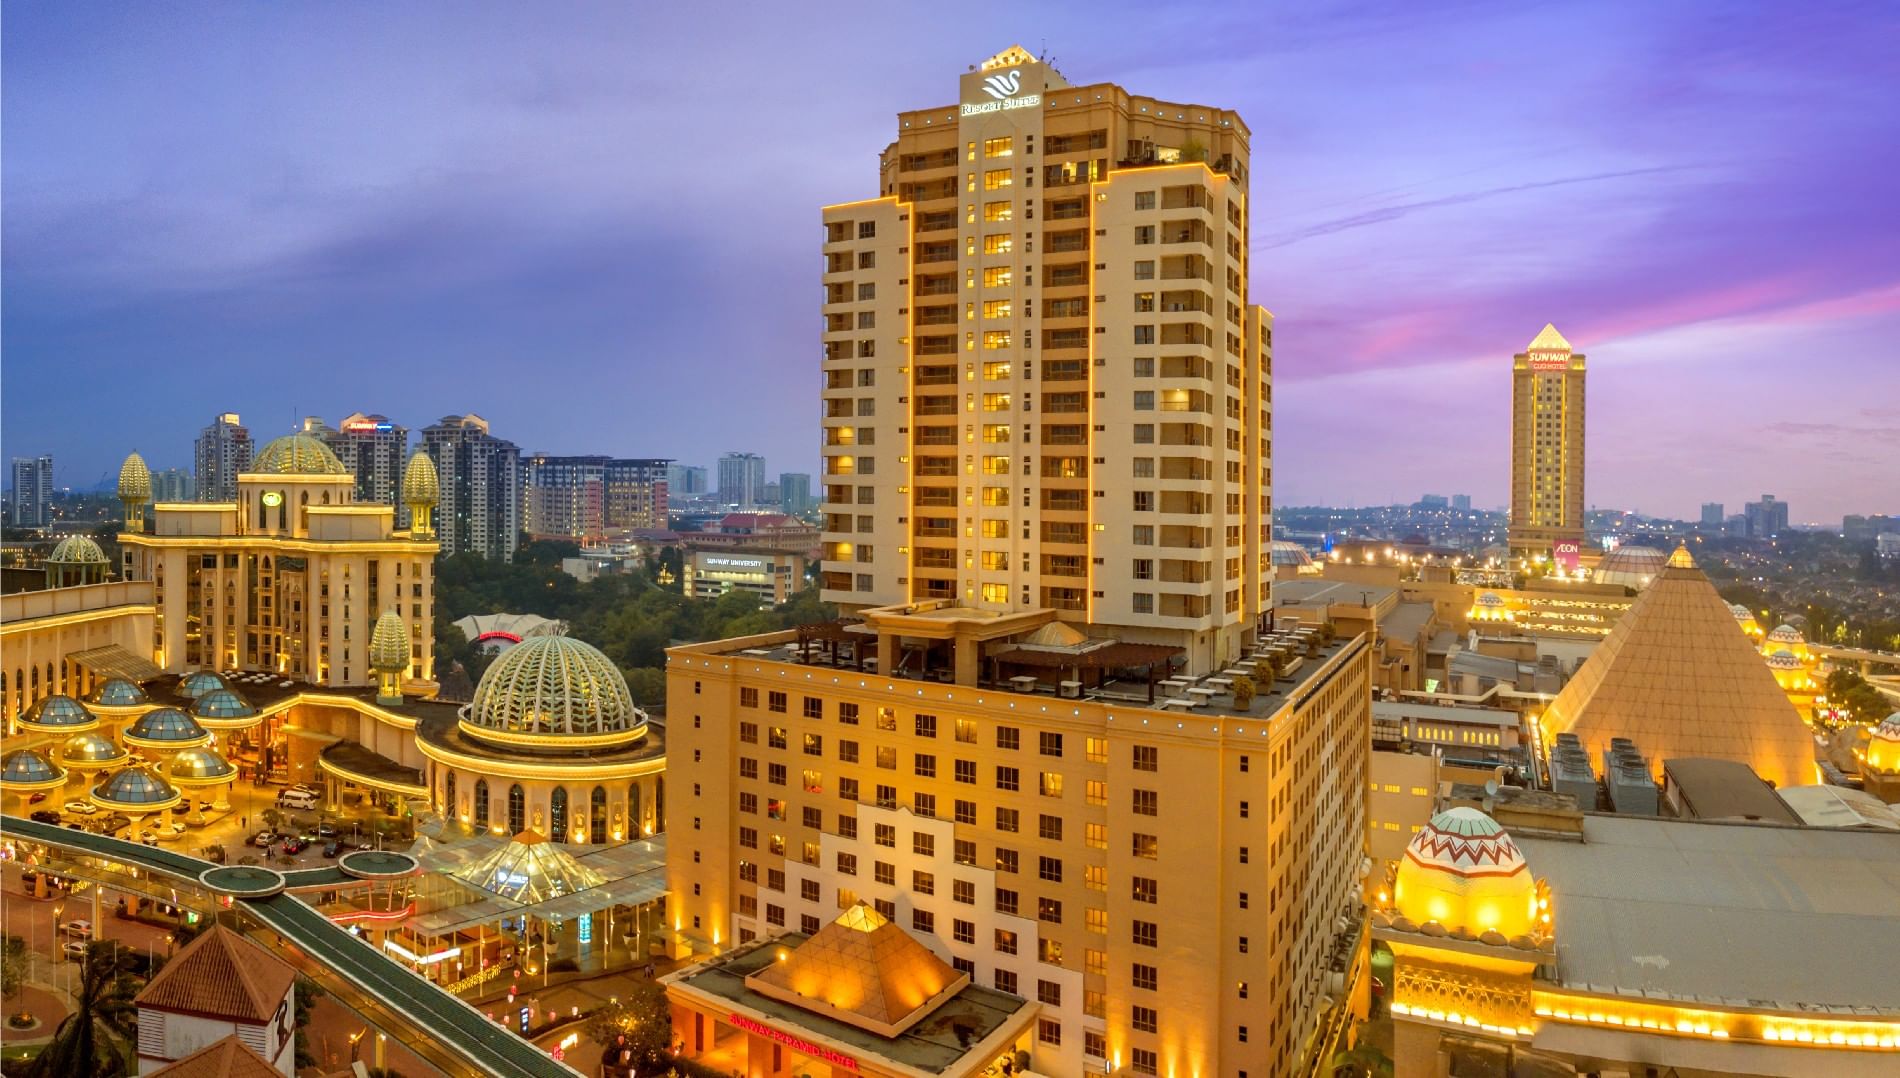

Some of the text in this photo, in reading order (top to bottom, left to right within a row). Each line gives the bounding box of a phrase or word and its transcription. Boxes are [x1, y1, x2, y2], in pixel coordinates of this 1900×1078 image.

[1528, 352, 1571, 362] SUNWAY
[730, 559, 762, 567] UNIVERSITY
[729, 1013, 860, 1072] SUNWAY PYRAMID HOTEL
